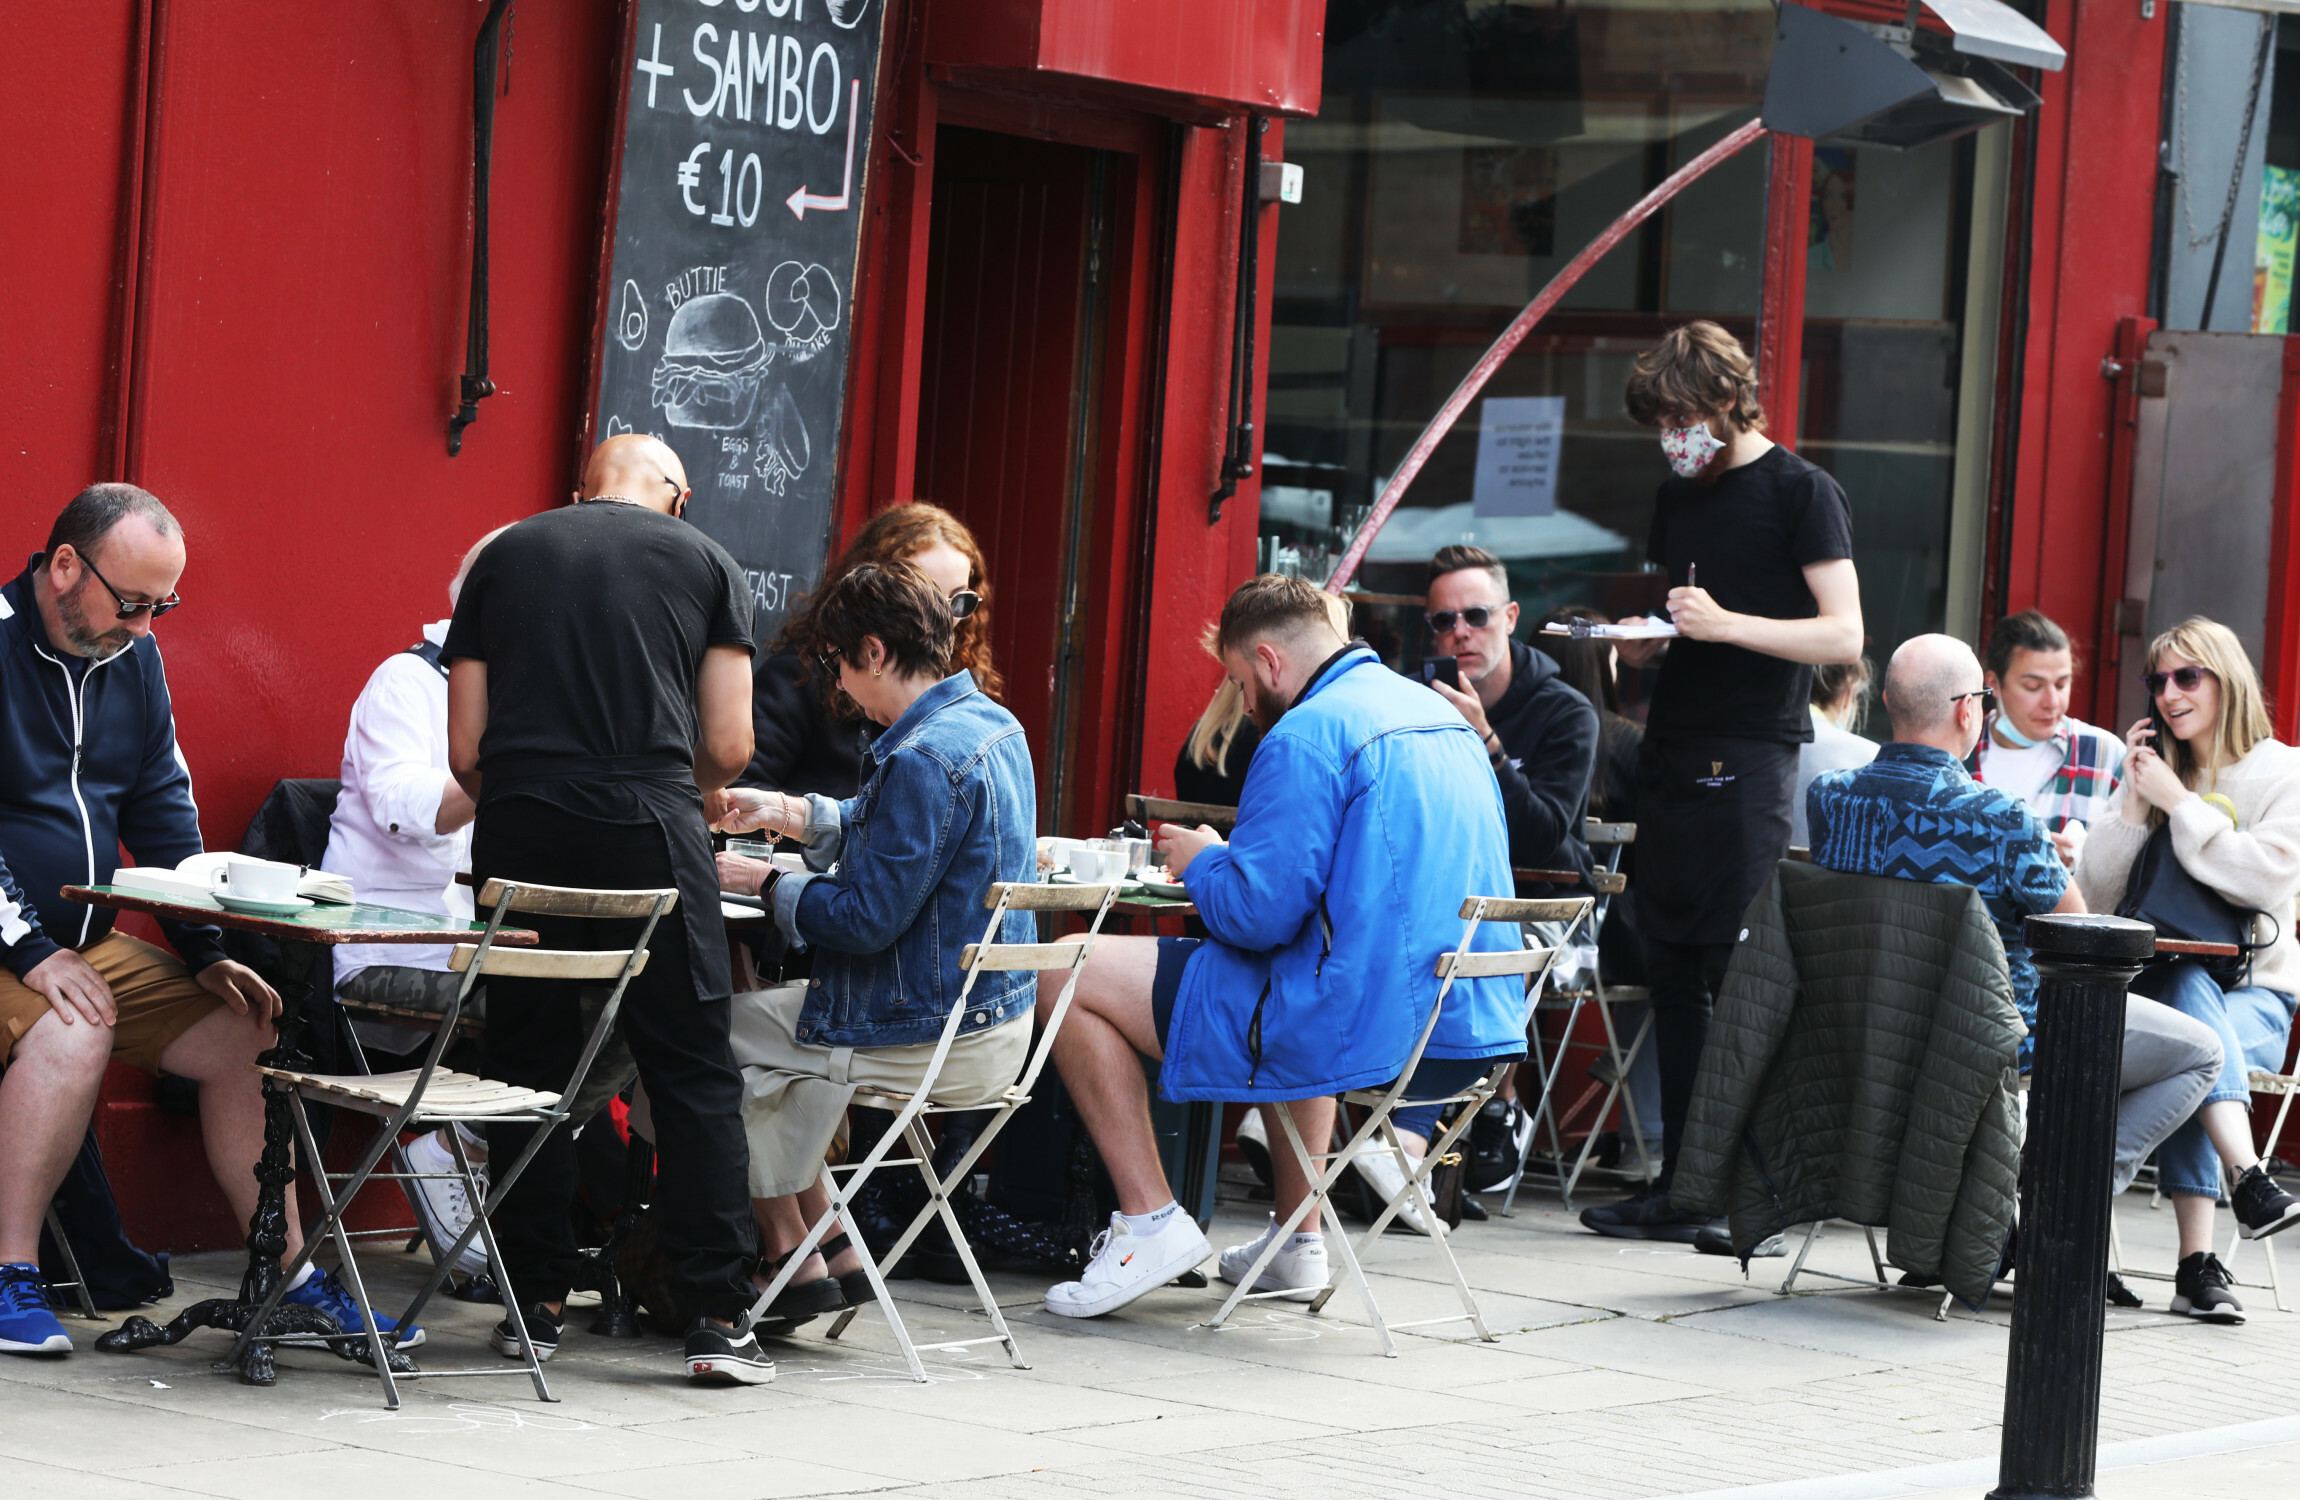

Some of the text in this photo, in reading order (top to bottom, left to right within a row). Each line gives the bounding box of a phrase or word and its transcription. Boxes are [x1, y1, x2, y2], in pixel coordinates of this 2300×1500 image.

[637, 22, 841, 135] + SAMBO
[677, 142, 763, 228] €10
[665, 266, 728, 312] BUTTIE
[721, 437, 749, 452] EGGS
[729, 455, 740, 470] &
[718, 474, 749, 489] TOAST
[744, 568, 793, 611] FAST
